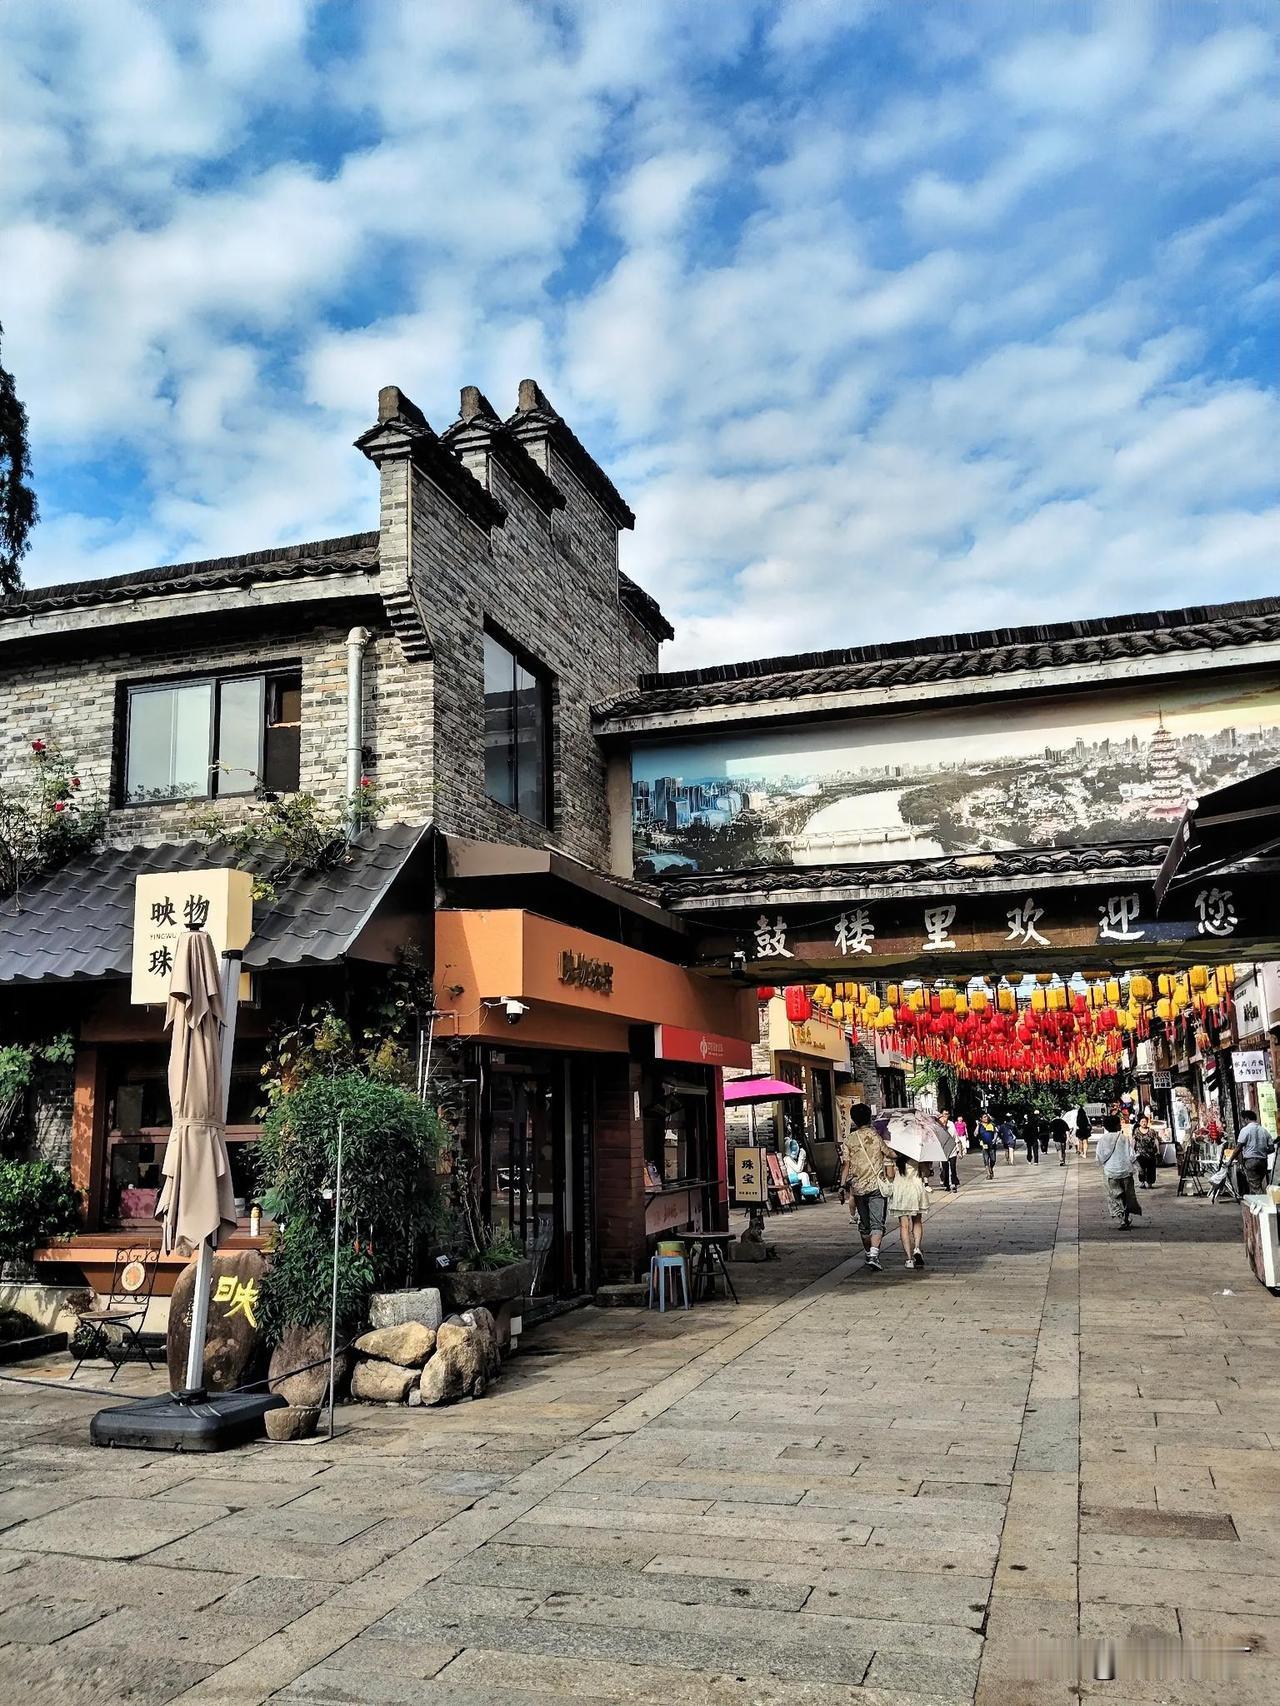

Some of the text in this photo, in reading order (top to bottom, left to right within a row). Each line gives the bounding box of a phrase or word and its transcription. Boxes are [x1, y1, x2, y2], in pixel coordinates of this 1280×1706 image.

[150, 894, 210, 928] 映物
[754, 888, 1236, 958] 鼓楼里欢迎您
[148, 945, 173, 978] 珠
[741, 1159, 754, 1184] 珠宝
[212, 1276, 258, 1328] 映
